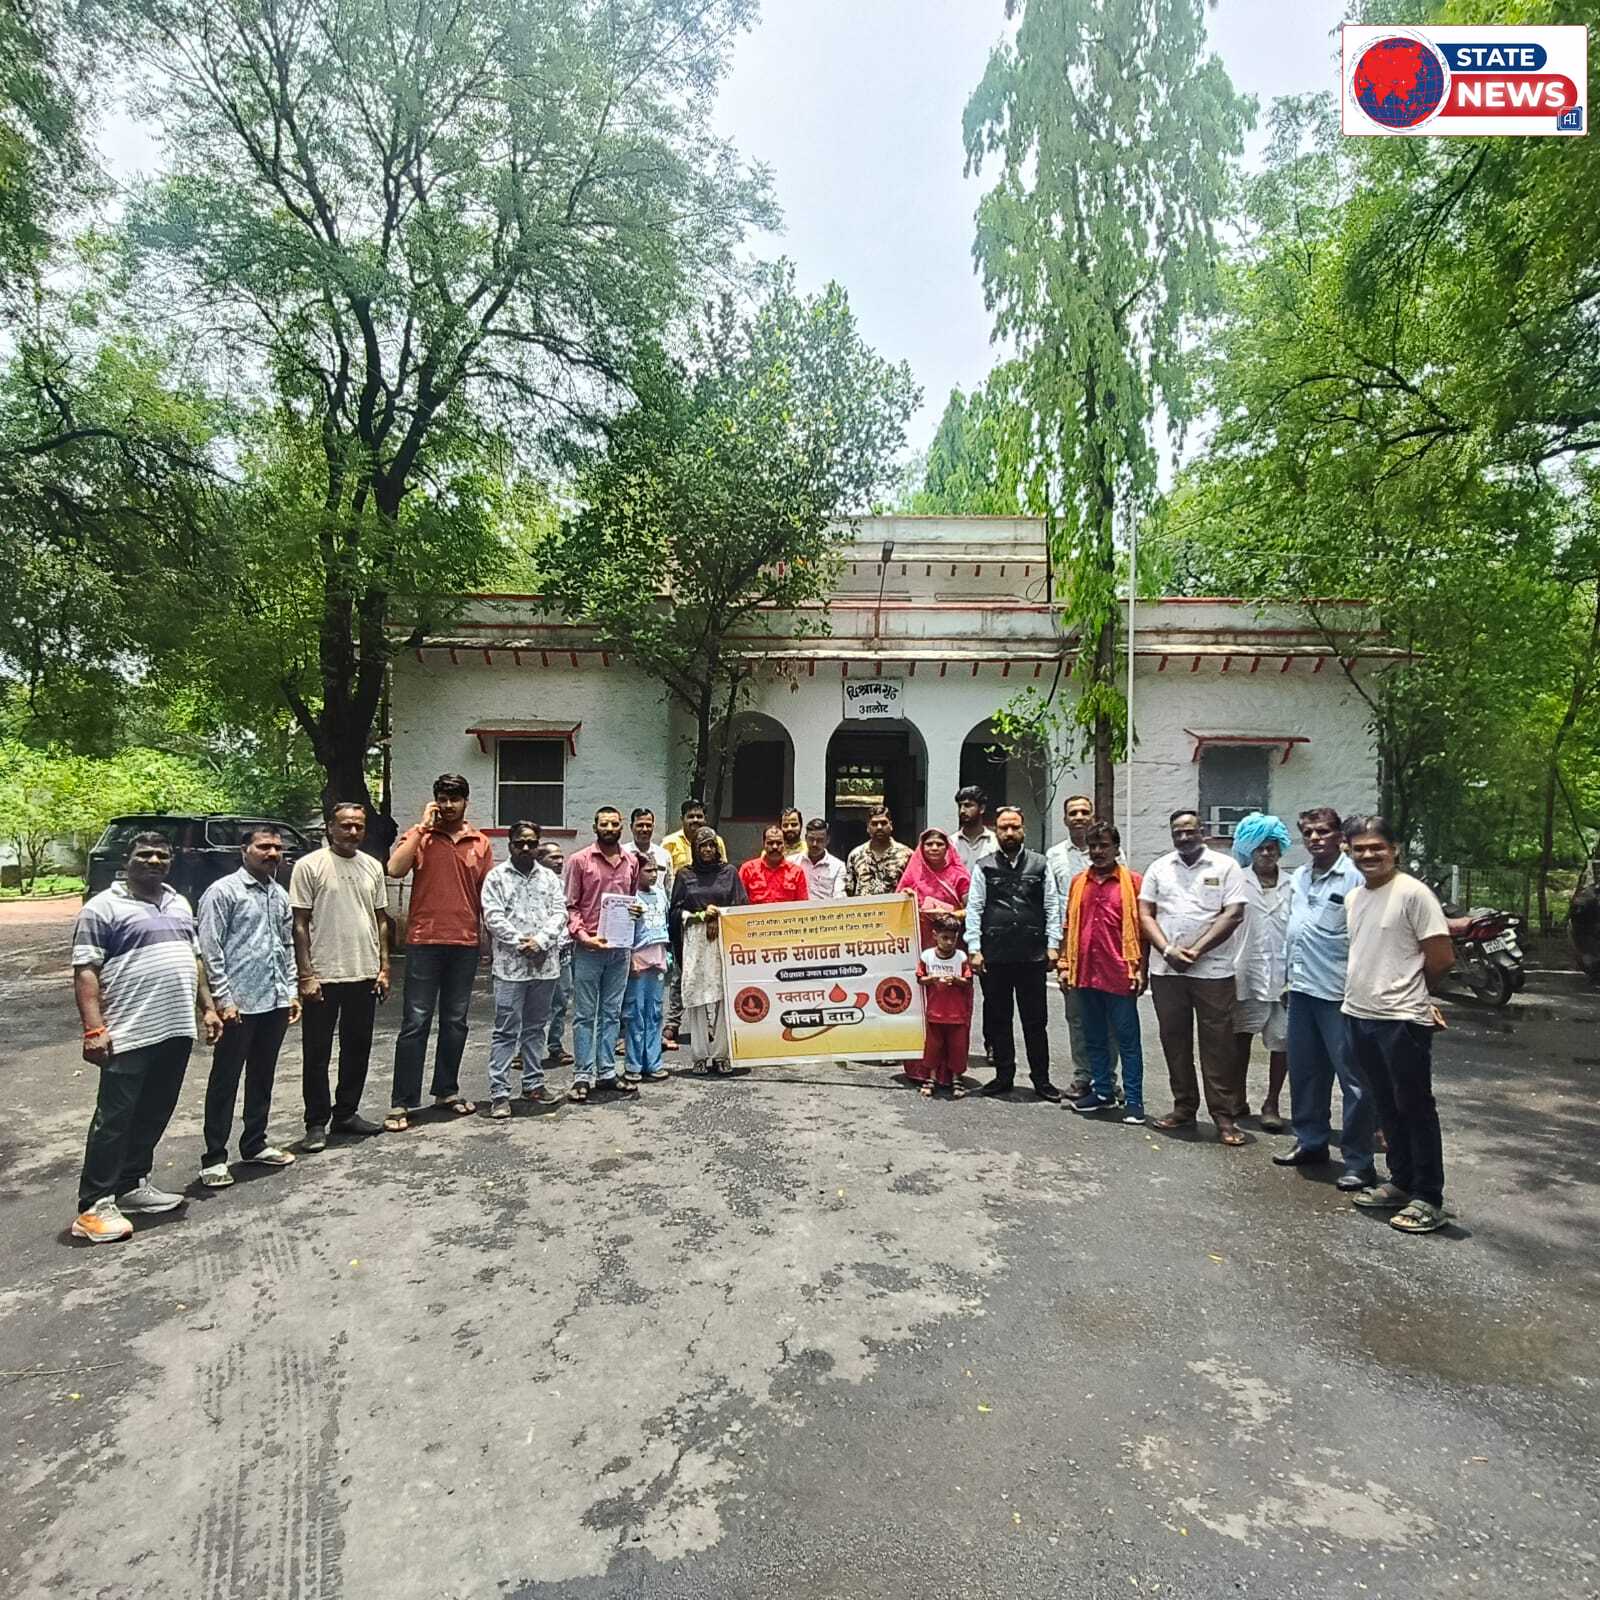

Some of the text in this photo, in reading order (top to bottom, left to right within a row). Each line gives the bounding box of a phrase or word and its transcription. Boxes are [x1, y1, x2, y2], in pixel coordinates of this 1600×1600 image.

[729, 943, 756, 966] विप्र
[761, 946, 788, 964] रक्त
[845, 932, 911, 958] मध्यप्रदेश
[776, 990, 825, 1004] रक्तदान
[782, 1010, 855, 1026] जीवन दान
